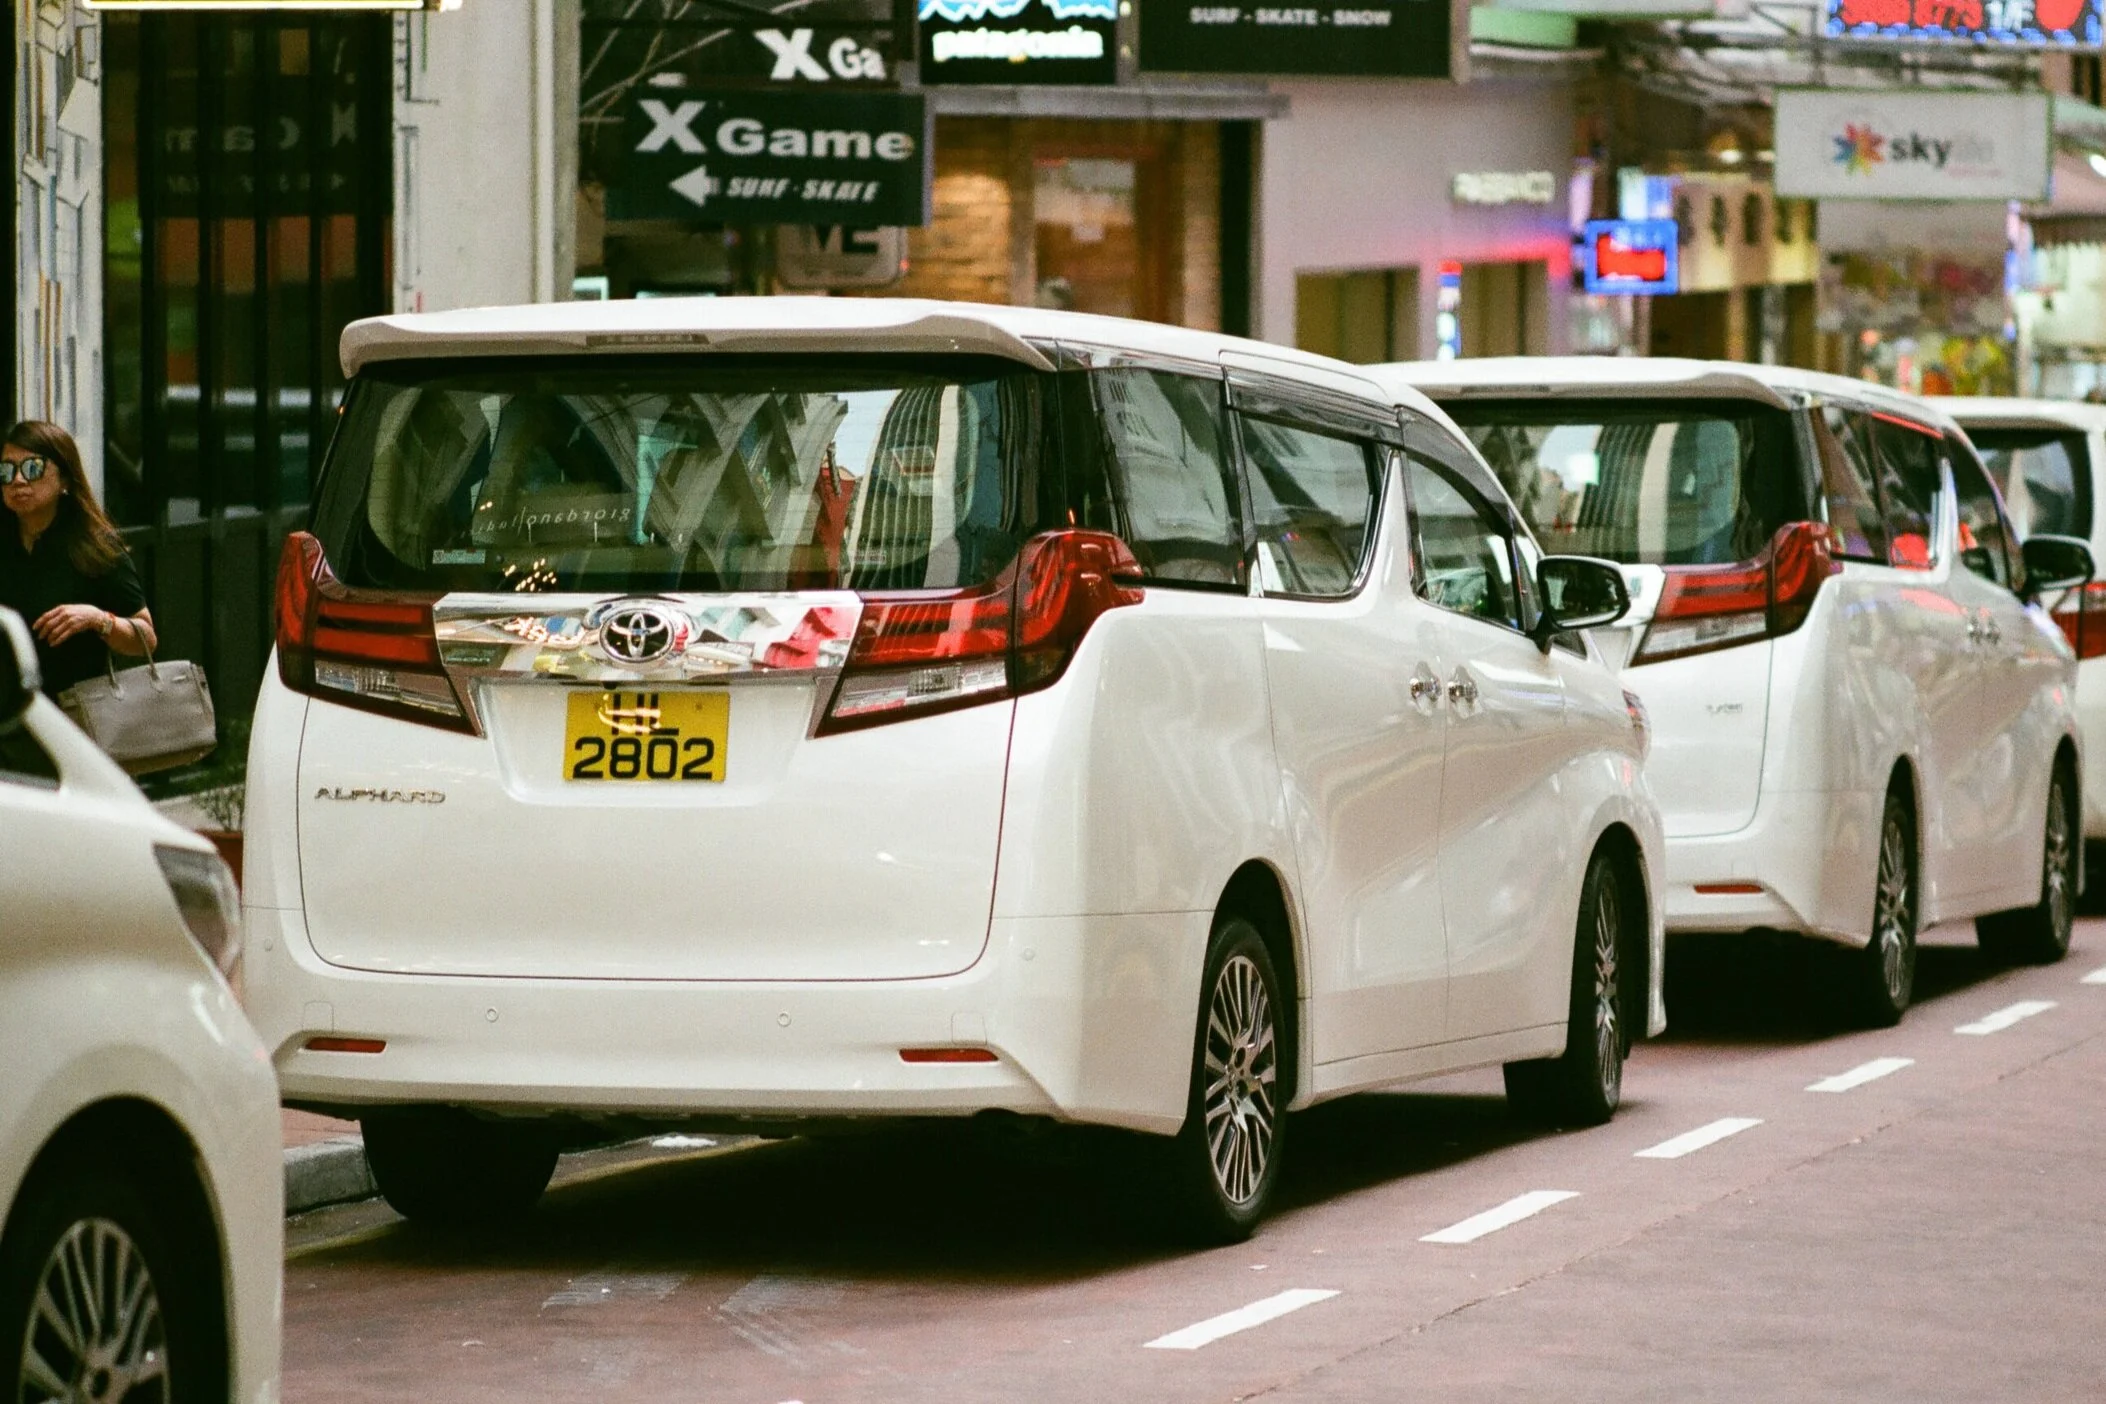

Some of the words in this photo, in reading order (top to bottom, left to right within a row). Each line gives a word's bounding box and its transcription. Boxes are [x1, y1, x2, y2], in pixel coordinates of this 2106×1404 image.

[1190, 7, 1240, 24] SURF
[1255, 8, 1318, 25] SKATE
[1333, 9, 1392, 26] SNOW
[753, 28, 830, 82] X
[635, 99, 708, 153] X
[716, 118, 915, 160] Game
[573, 736, 715, 780] 2802
[314, 788, 446, 804] ALPHARD
